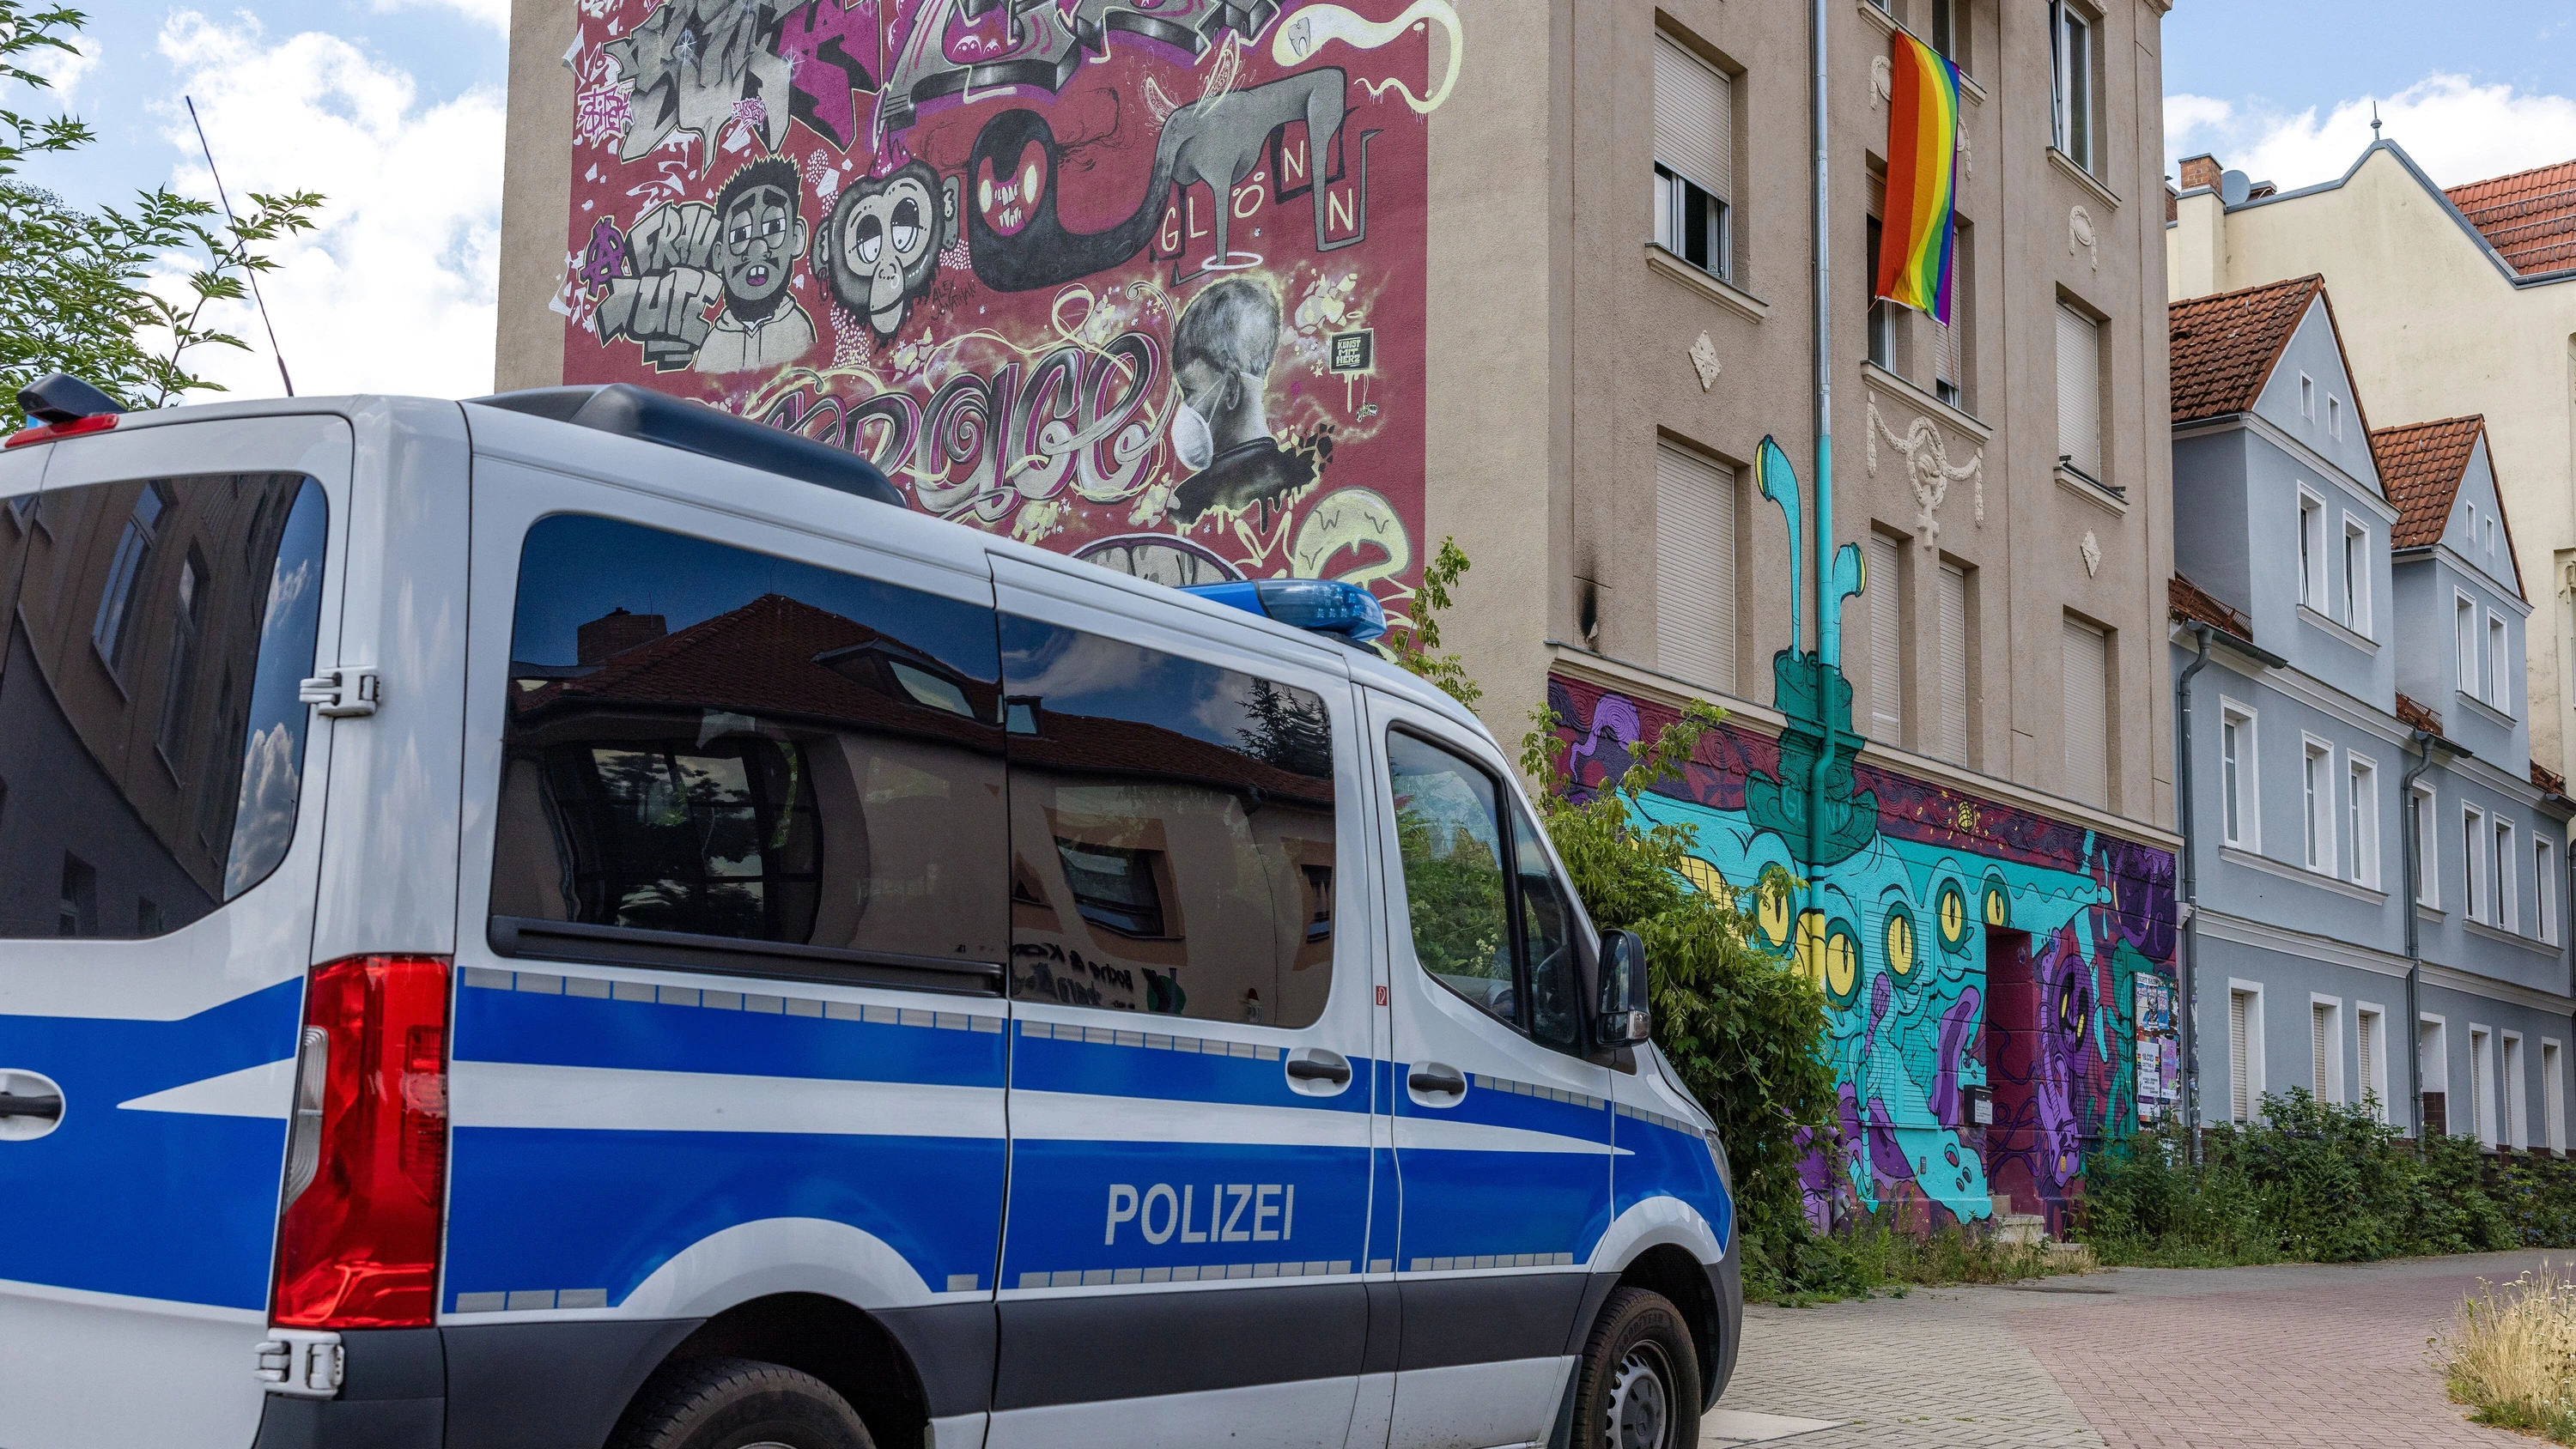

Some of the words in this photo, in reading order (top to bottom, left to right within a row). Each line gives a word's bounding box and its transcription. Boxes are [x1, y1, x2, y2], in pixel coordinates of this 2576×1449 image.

[1337, 339, 1361, 349] KUNST
[1338, 348, 1358, 356] MIT
[1336, 354, 1360, 365] HERZ
[1104, 1183, 1295, 1246] POLIZEI
